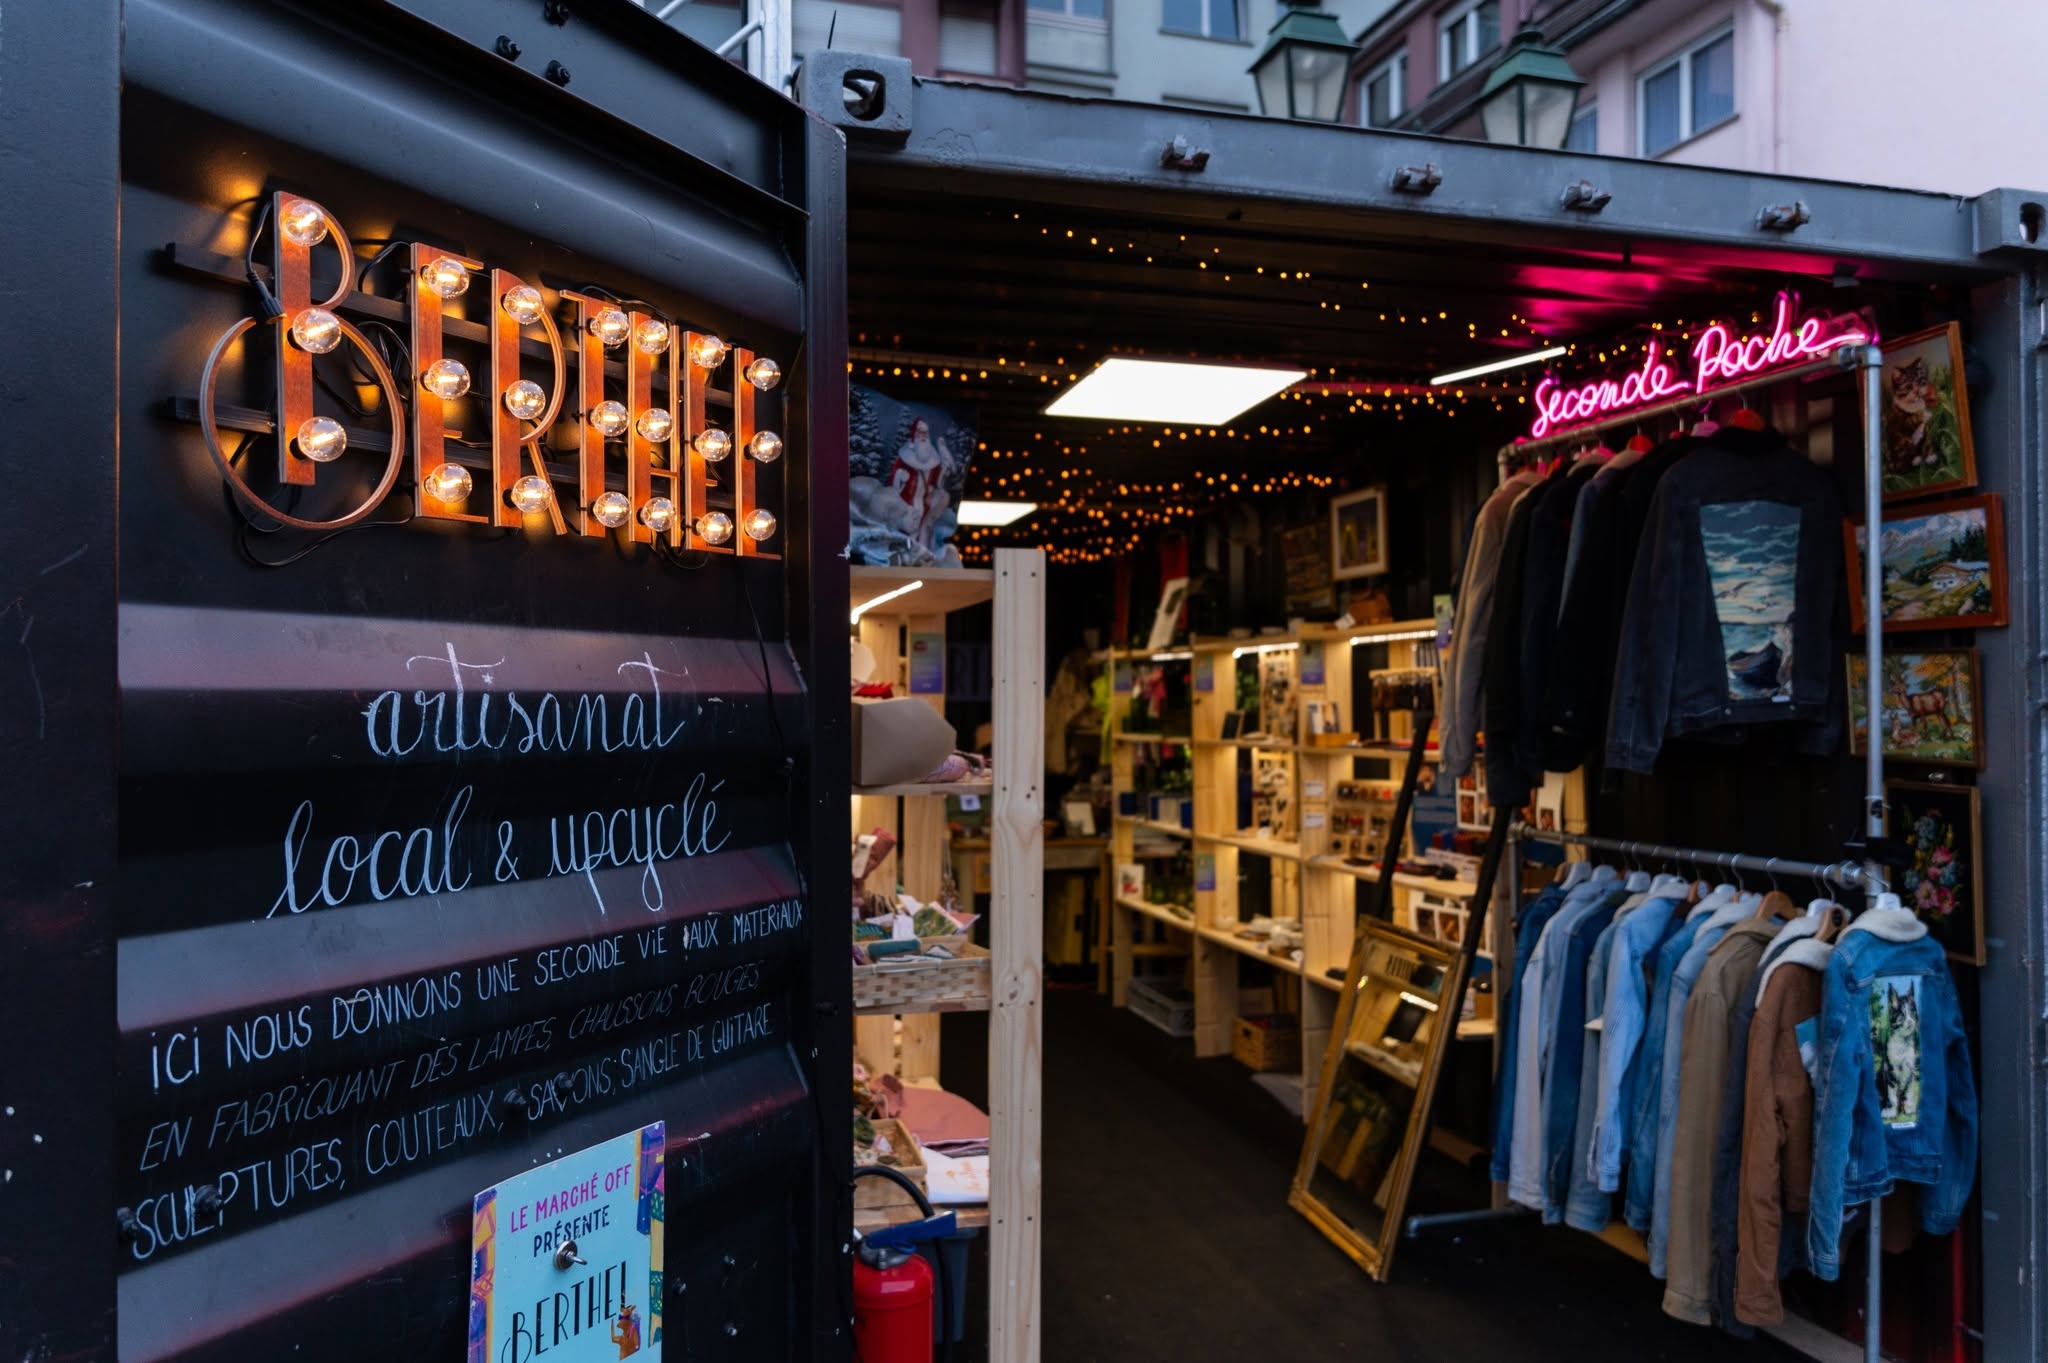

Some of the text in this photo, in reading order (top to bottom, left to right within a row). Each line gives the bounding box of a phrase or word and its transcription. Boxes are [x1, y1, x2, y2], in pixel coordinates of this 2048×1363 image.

[200, 190, 783, 561] BERTHEL
[1531, 297, 1867, 438] Seconde Poche
[364, 641, 689, 757] artisanat
[266, 772, 733, 920] local & upcyclé
[225, 1003, 313, 1070] NOUS
[331, 971, 462, 1041] DONNONS
[476, 957, 521, 1001] UNE
[533, 934, 626, 987] SECONDE
[688, 912, 719, 951] AUX
[131, 1137, 347, 1261] SCULPTURES,
[365, 1088, 505, 1175] COUTEAUX,
[621, 1032, 682, 1089] SANGLE
[687, 1024, 706, 1061] DE
[139, 1115, 193, 1172] EN
[467, 1016, 558, 1072] LAMPES,
[510, 1163, 632, 1234] LE MARCHÉ OFF
[533, 1204, 611, 1258] PRÉSENTE
